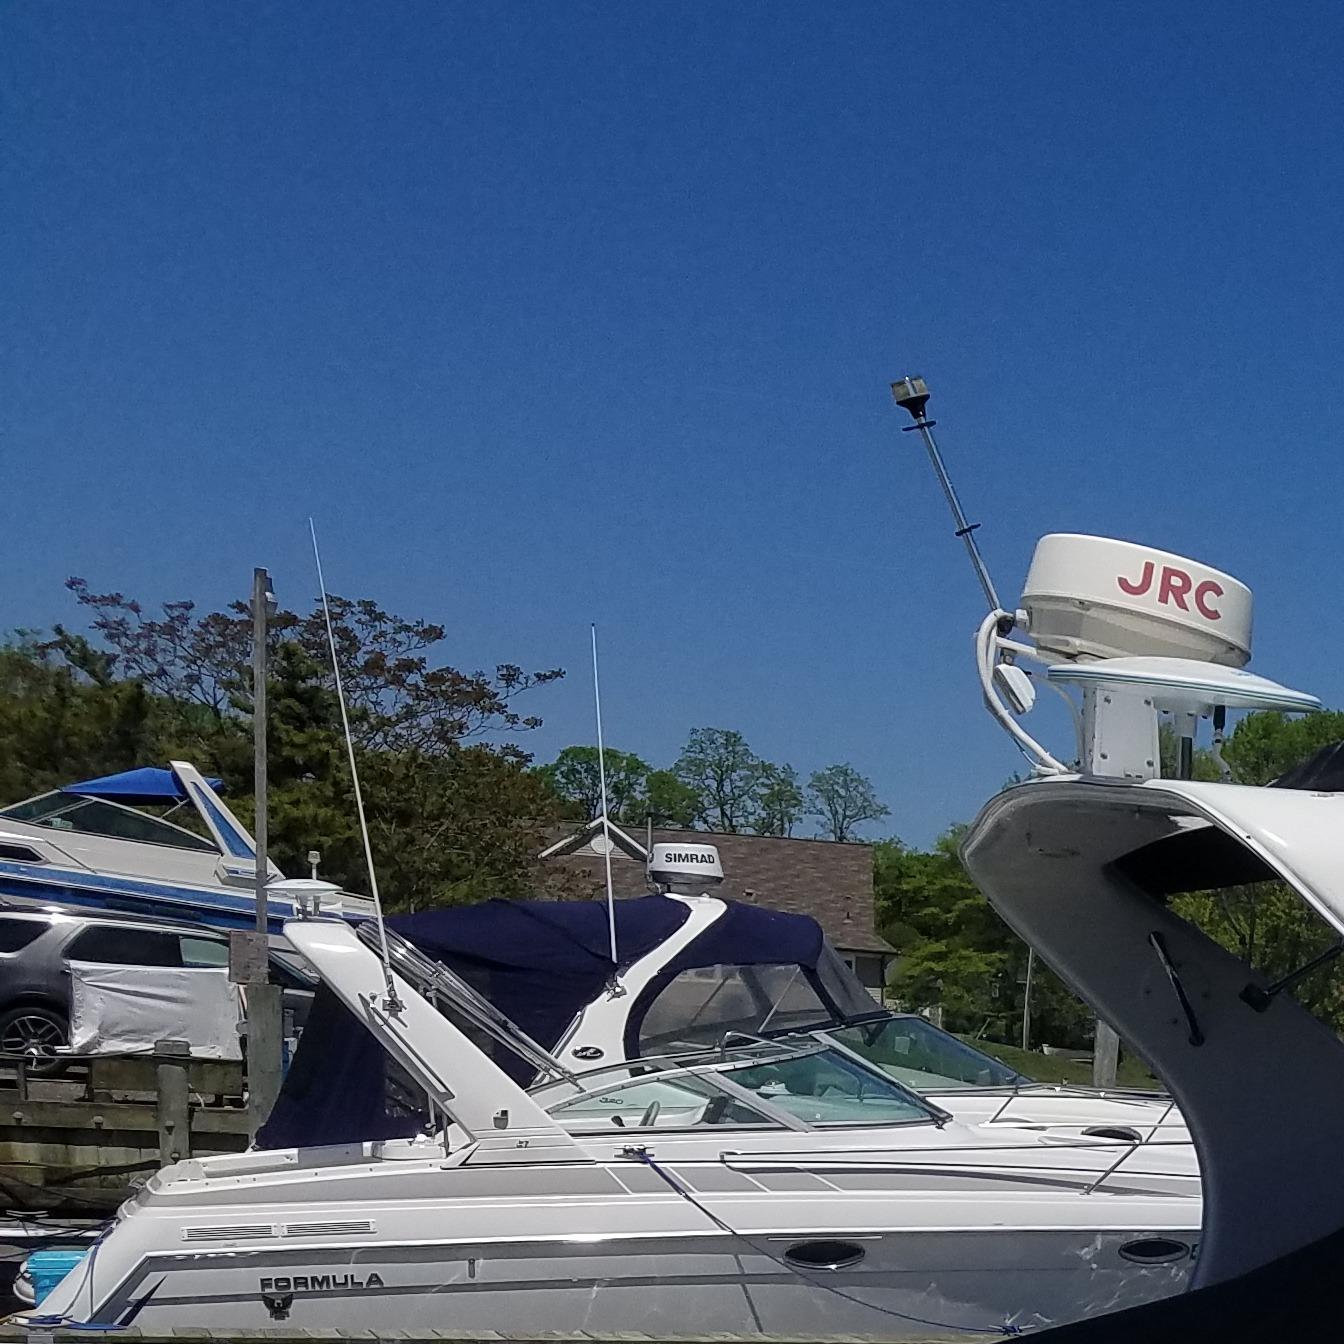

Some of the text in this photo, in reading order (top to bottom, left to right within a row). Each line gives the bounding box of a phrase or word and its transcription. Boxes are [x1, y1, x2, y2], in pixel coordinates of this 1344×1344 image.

[1117, 561, 1224, 620] JRC
[665, 853, 715, 864] SIMRAD
[260, 1272, 384, 1292] FORMULA
